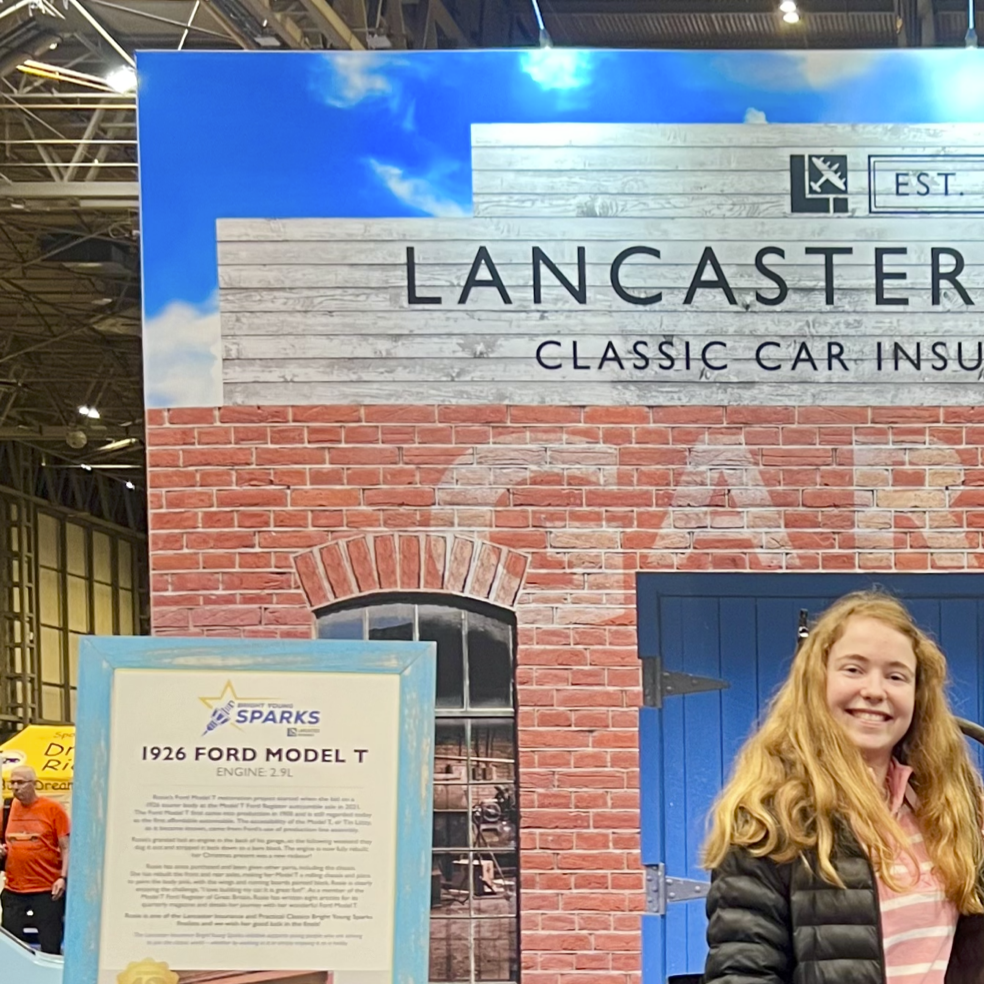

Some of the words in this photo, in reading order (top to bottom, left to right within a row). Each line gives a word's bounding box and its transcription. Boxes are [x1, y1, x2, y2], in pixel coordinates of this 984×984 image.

[895, 172, 965, 196] EST.
[405, 245, 976, 306] LANCASTER
[535, 340, 729, 371] CLASSIC
[754, 340, 850, 371] CAR
[236, 709, 320, 725] SPARKS
[142, 746, 186, 761] 1926
[194, 747, 257, 762] FORD
[265, 747, 346, 763] MODEL
[353, 749, 369, 763] T
[216, 767, 268, 777] ENGINE:
[270, 767, 293, 778] 2.9L
